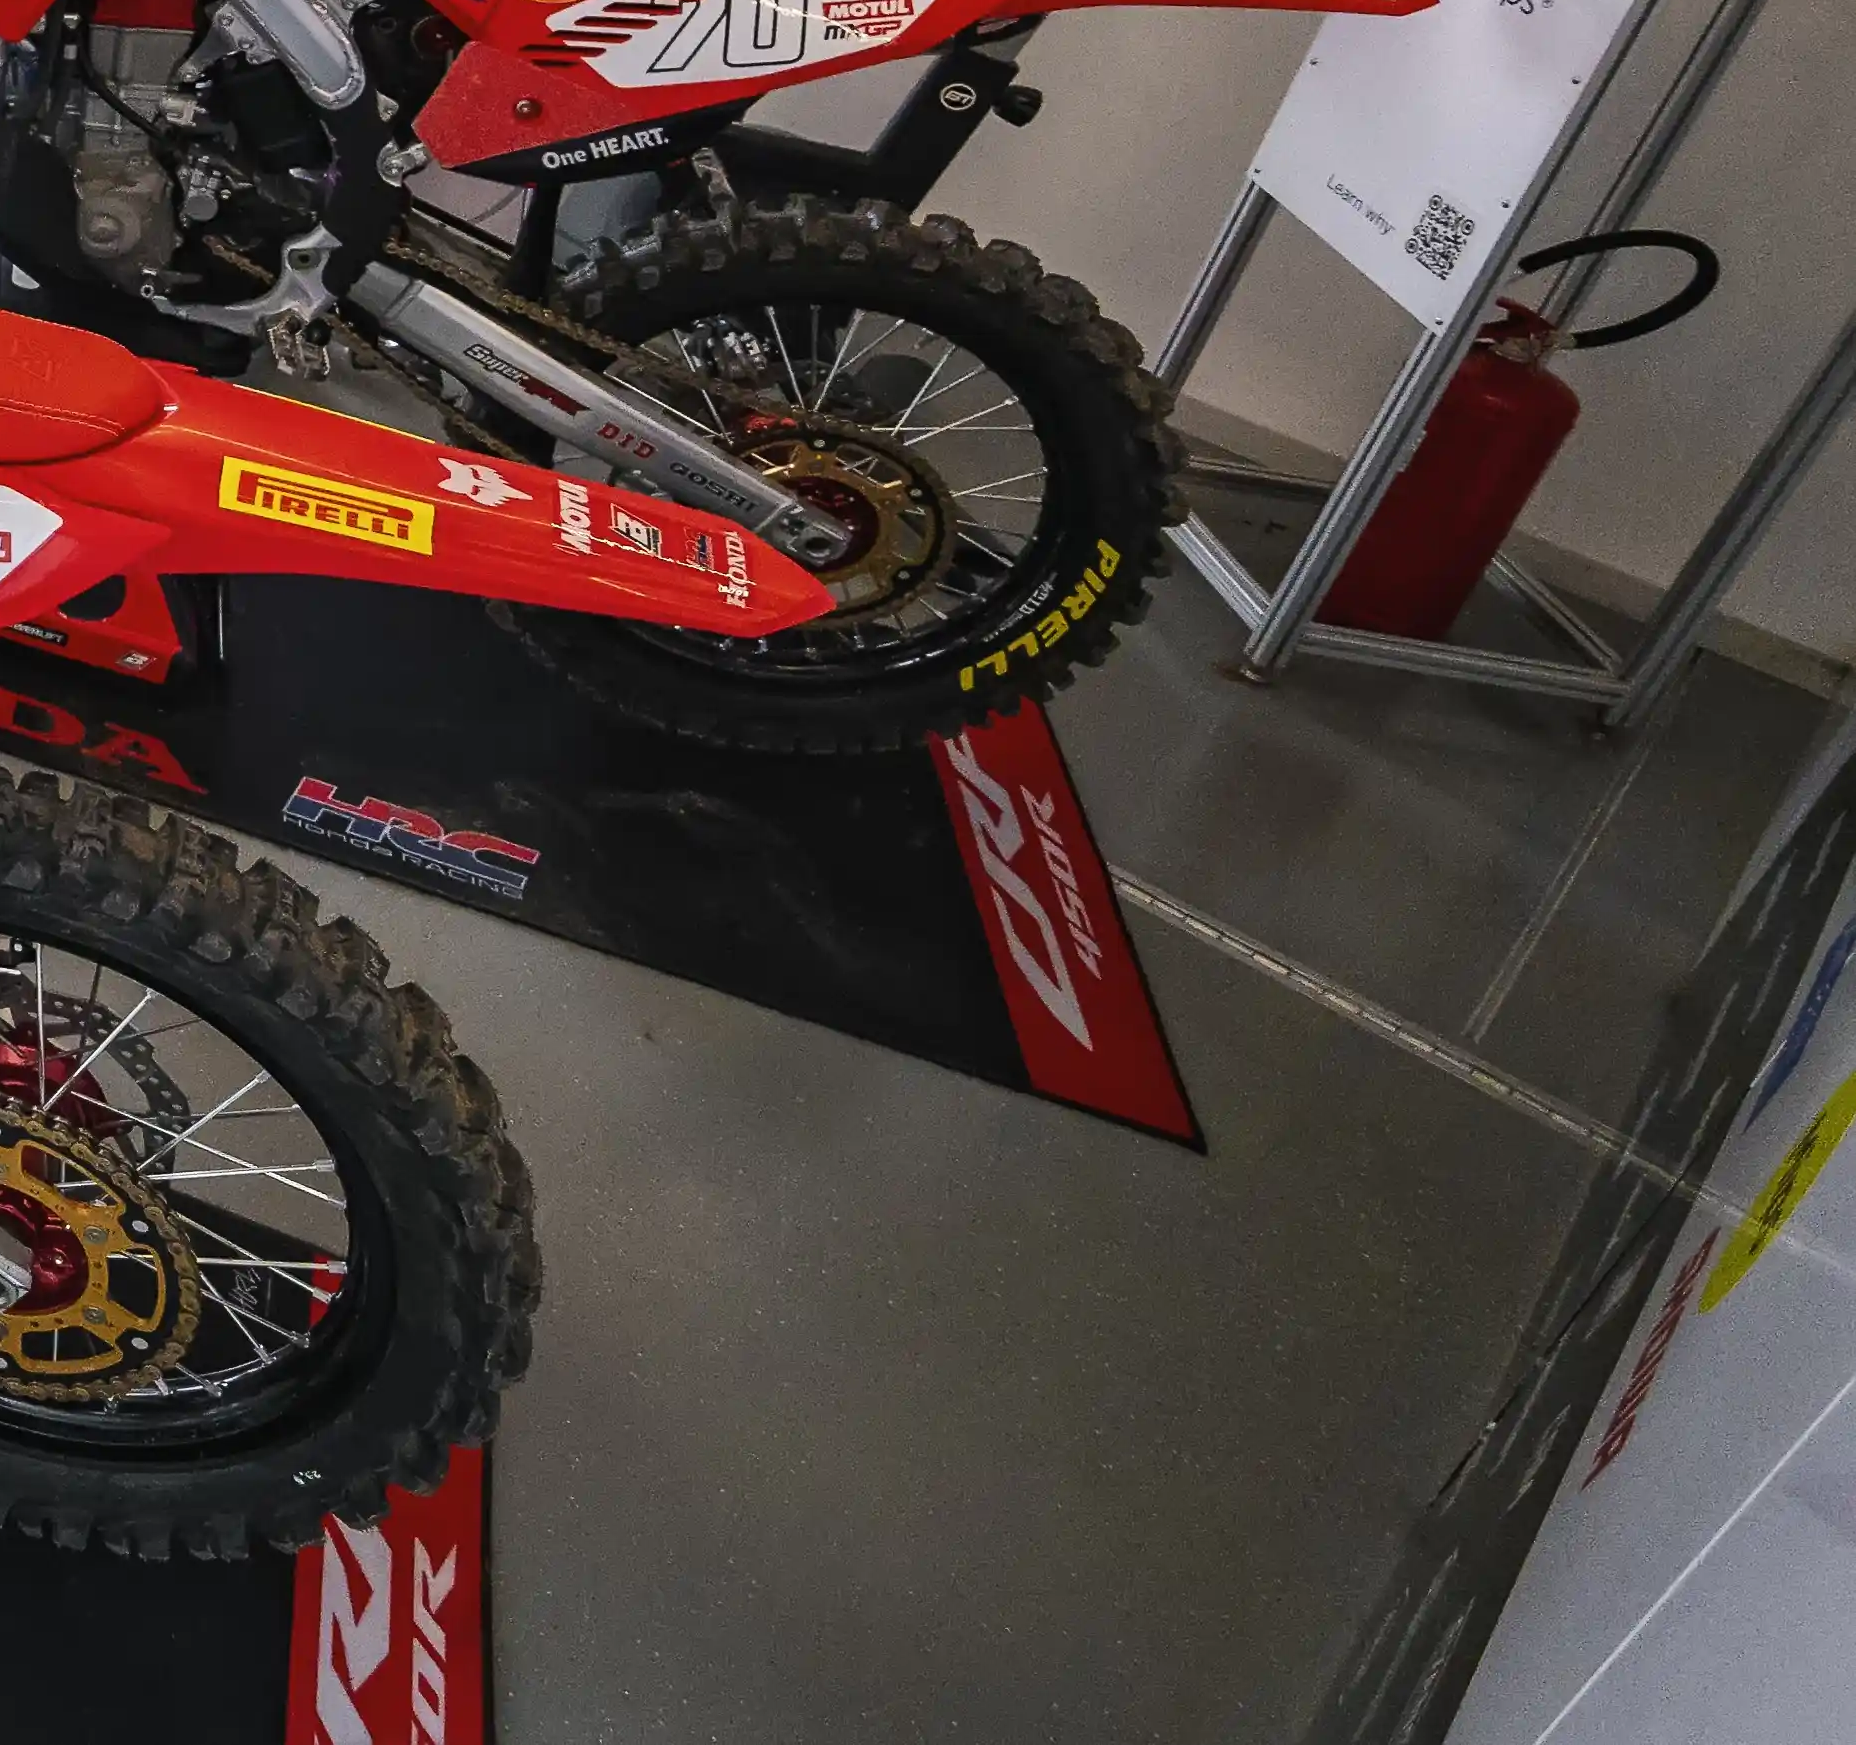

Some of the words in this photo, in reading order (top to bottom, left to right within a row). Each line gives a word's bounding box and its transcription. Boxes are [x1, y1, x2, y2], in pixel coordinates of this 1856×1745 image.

[542, 147, 587, 169] One
[589, 127, 670, 161] HEART.
[1327, 174, 1363, 213] Learn
[1364, 205, 1396, 235] why
[237, 470, 413, 539] PIRELLI
[959, 538, 1121, 691] PIRELLI
[283, 777, 540, 888] HRC
[284, 814, 392, 856] Honda
[402, 855, 523, 900] RACING
[1014, 783, 1102, 979] 450R
